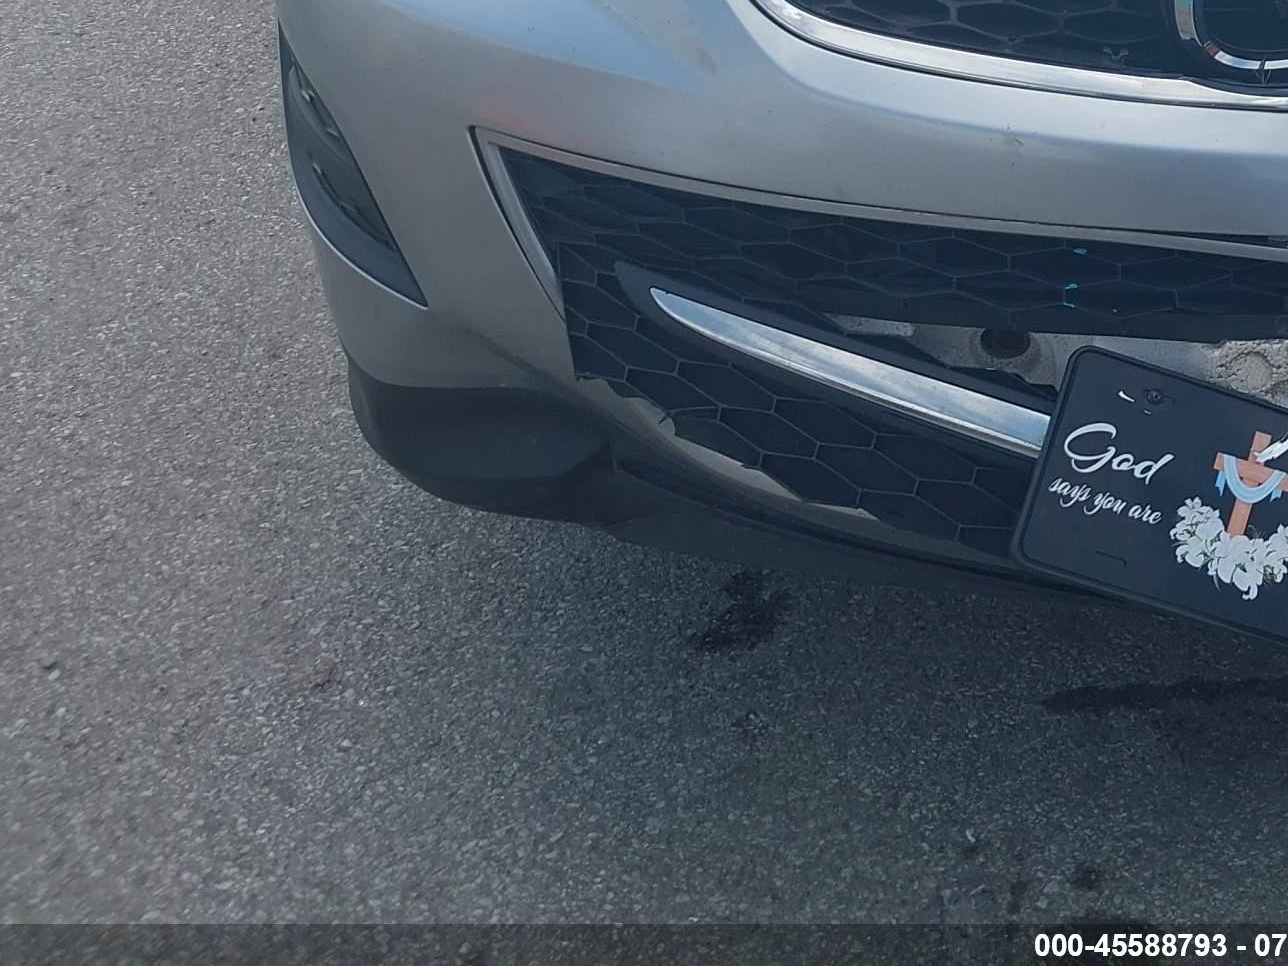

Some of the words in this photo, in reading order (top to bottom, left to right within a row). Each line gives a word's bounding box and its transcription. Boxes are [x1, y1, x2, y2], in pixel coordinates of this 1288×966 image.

[1064, 422, 1175, 484] God
[1048, 478, 1091, 507] says
[1083, 492, 1127, 514] you
[1128, 504, 1162, 524] are
